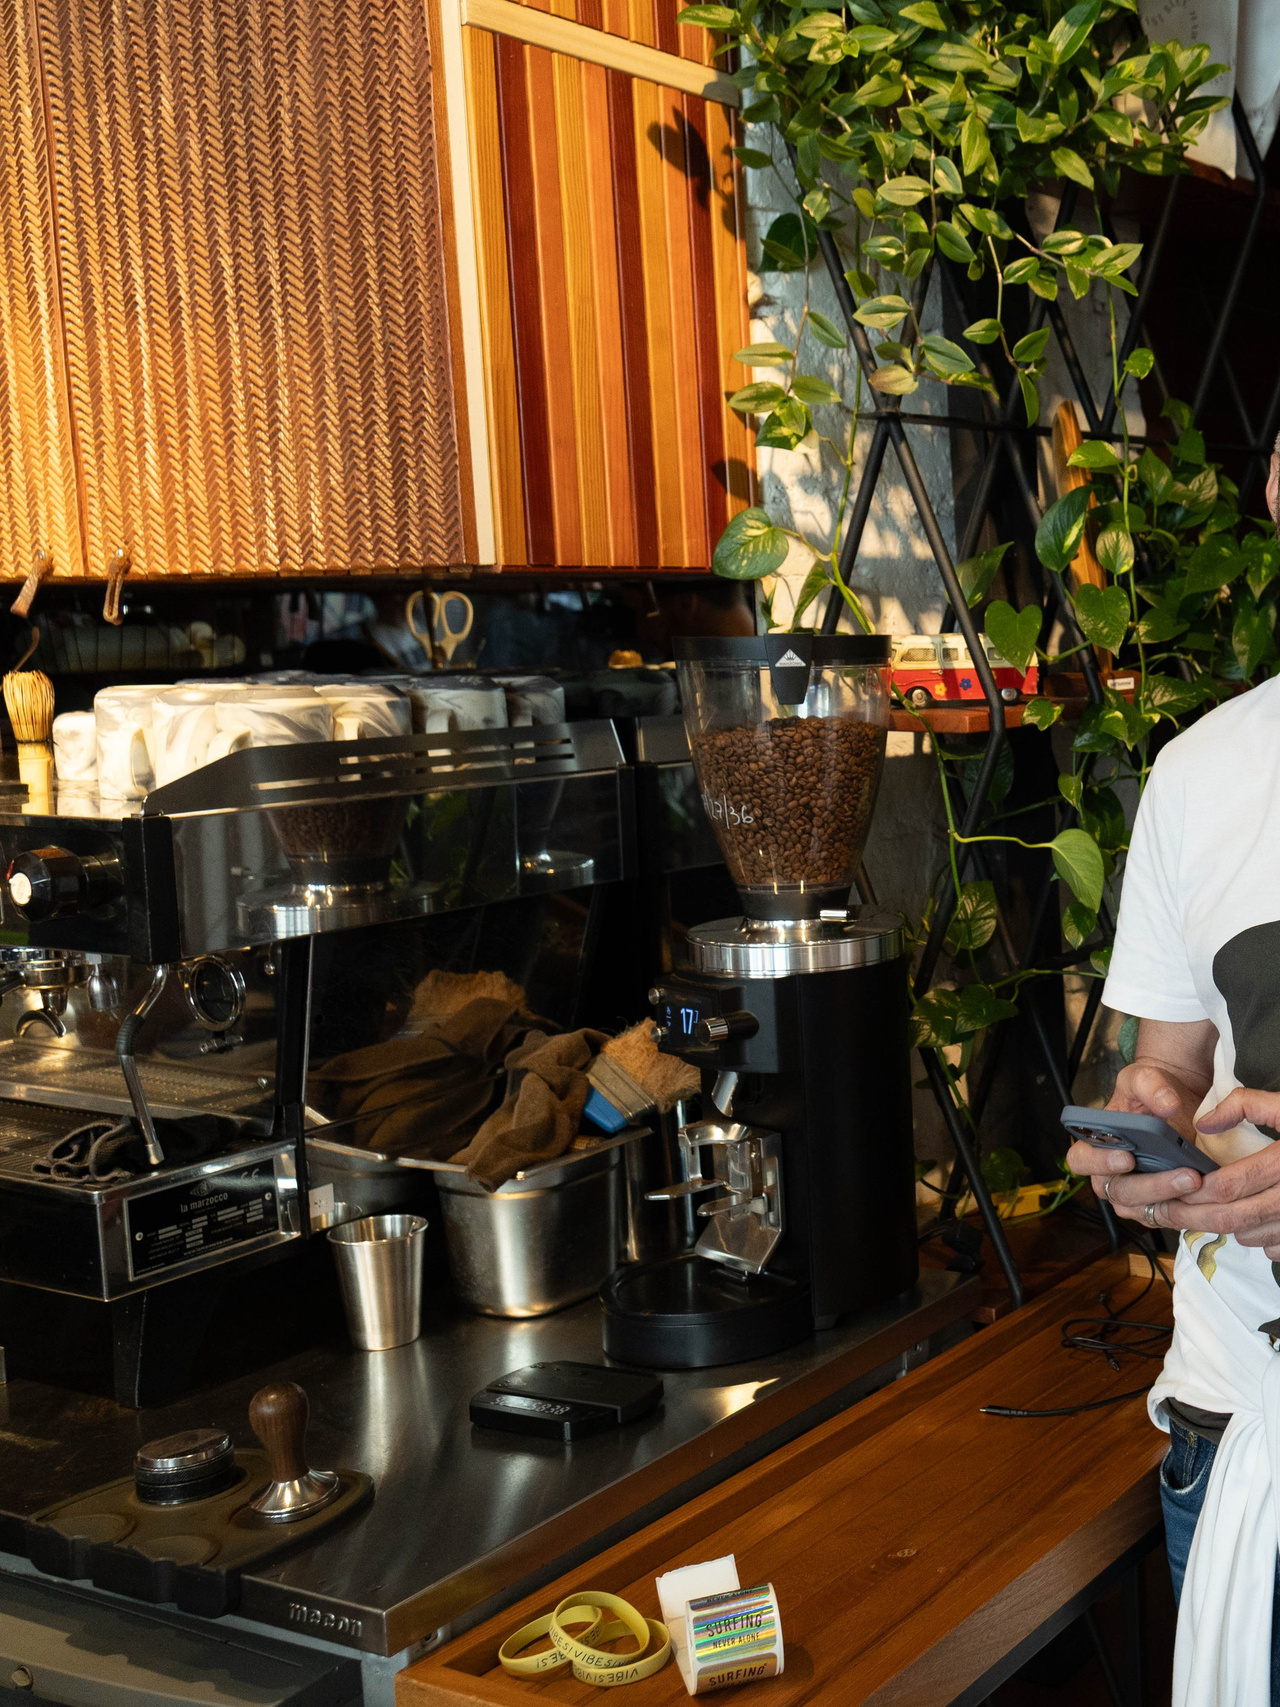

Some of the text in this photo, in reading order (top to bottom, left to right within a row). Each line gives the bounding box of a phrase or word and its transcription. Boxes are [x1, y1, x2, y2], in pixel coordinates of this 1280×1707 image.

[180, 1202, 189, 1213] la
[190, 1192, 229, 1211] marzocco
[706, 1613, 763, 1637] SURFING
[712, 1632, 760, 1649] NEVER ALONE
[709, 1665, 765, 1686] SURFING
